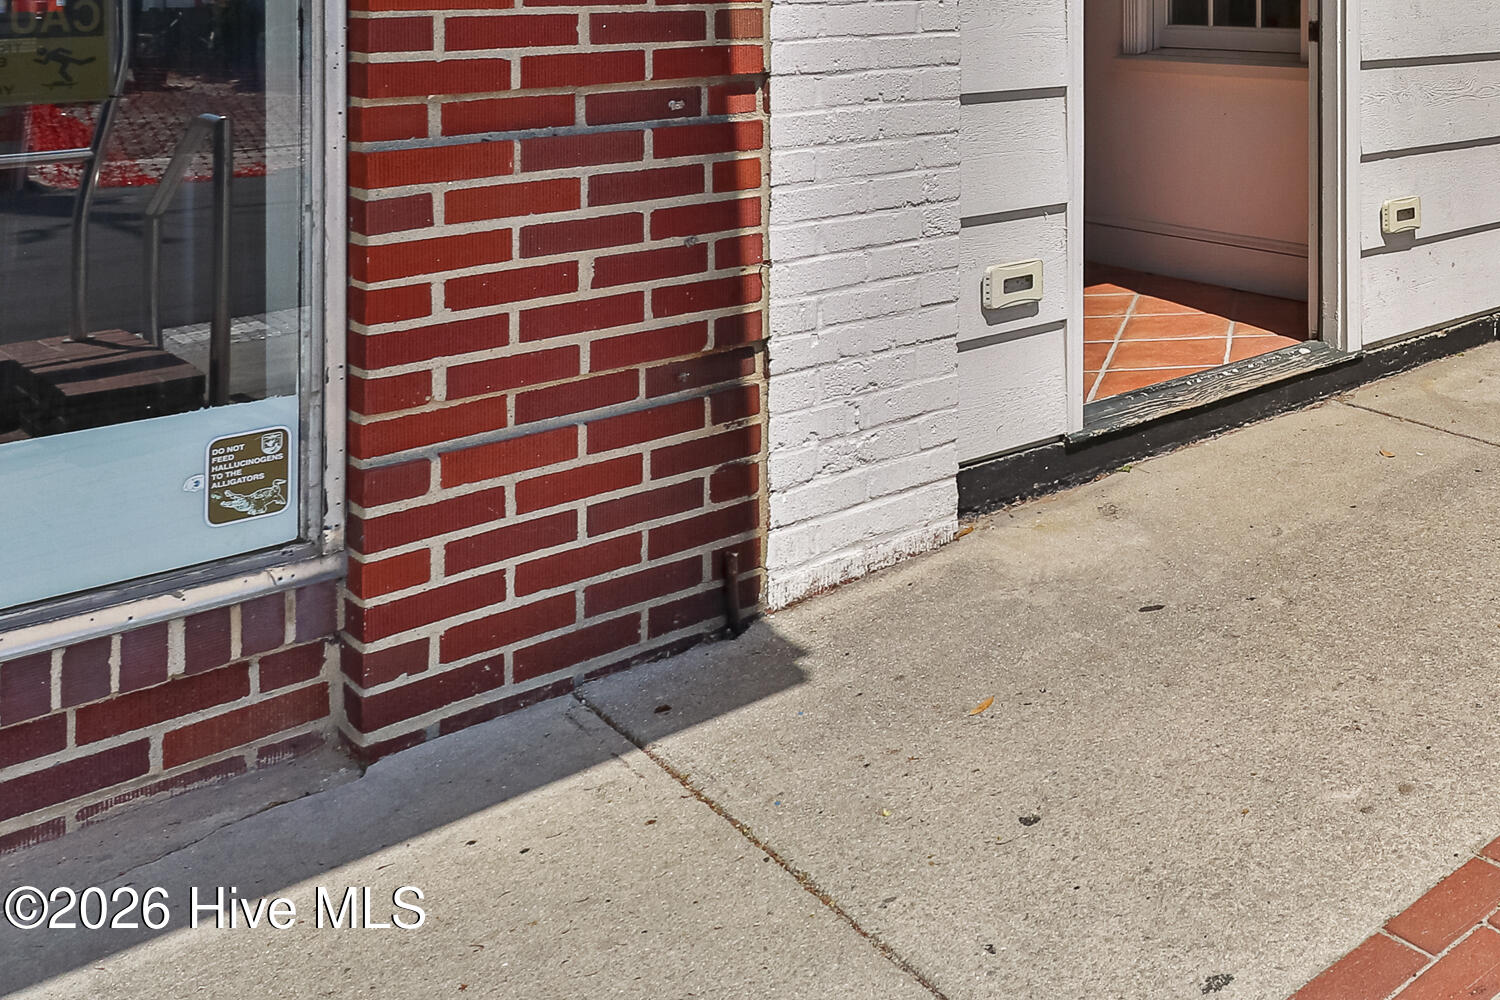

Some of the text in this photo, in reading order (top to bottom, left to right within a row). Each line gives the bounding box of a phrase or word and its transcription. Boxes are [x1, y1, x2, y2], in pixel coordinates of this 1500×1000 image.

[212, 443, 245, 456] DO NOT
[211, 454, 235, 464] FEED
[211, 453, 284, 472] HALLUCINOGENS
[211, 469, 242, 481] TO THE
[211, 472, 265, 489] ALLIGATORS
